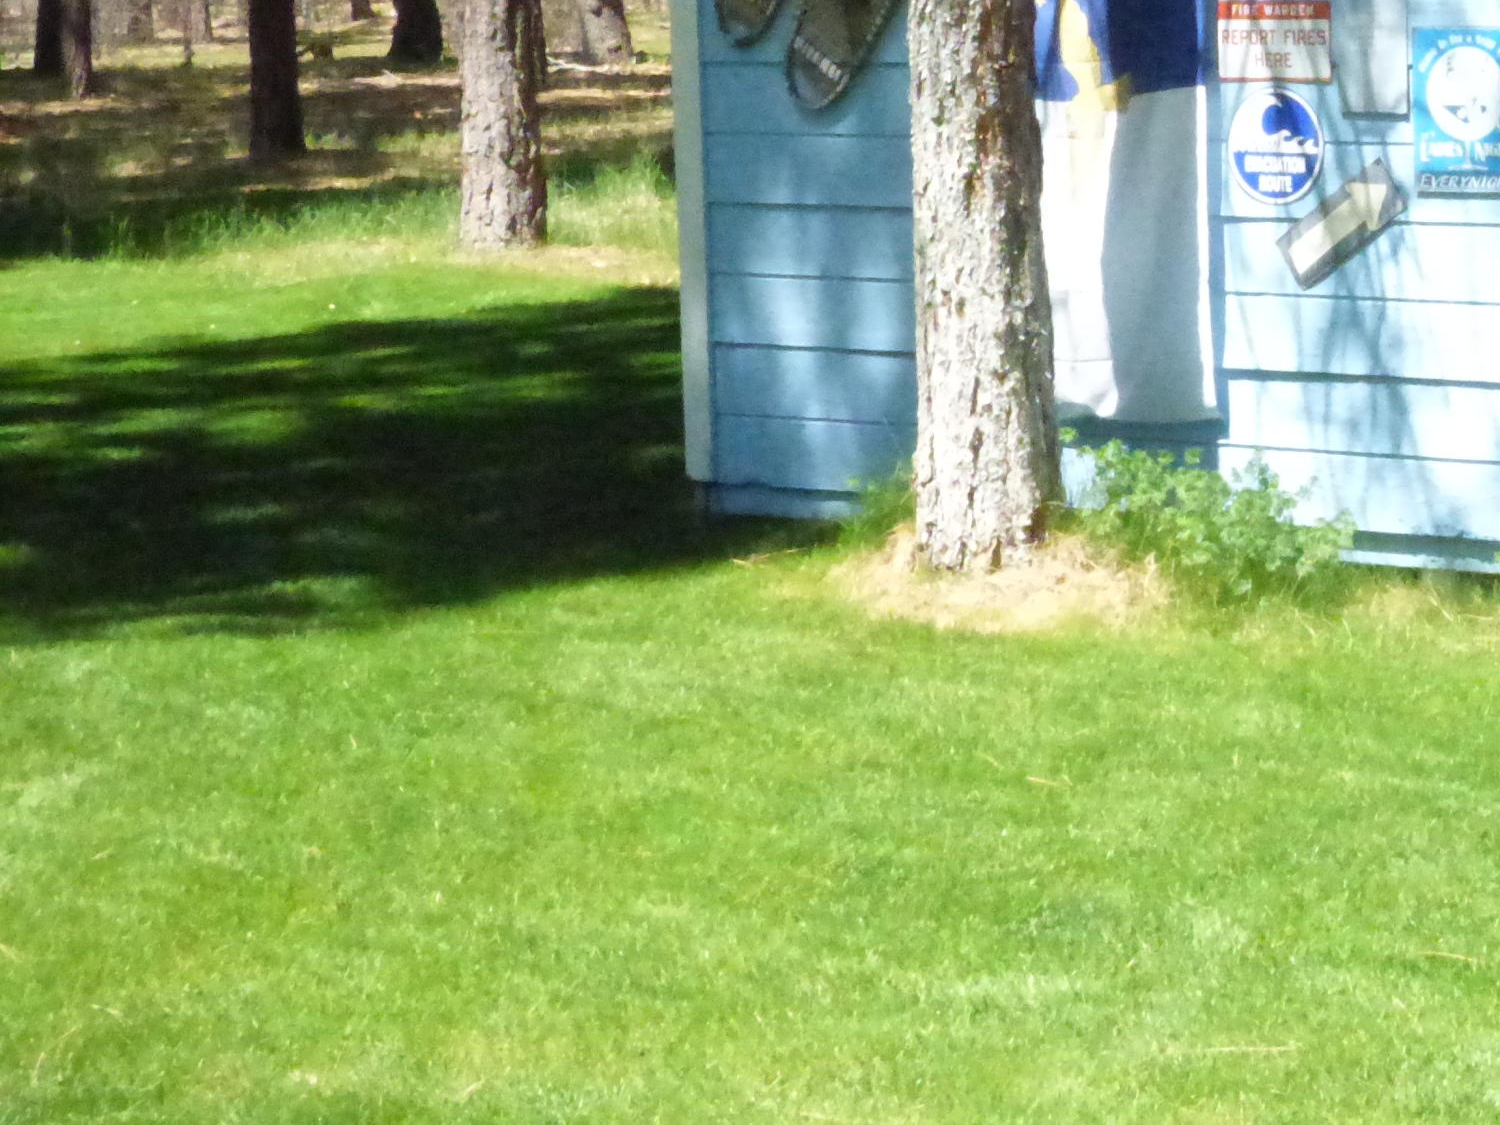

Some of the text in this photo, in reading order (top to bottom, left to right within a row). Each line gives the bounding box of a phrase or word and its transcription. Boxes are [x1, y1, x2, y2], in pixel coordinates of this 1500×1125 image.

[1231, 4, 1258, 16] FIRE
[1221, 29, 1327, 46] REPORT FIRES
[1255, 52, 1293, 68] HERE
